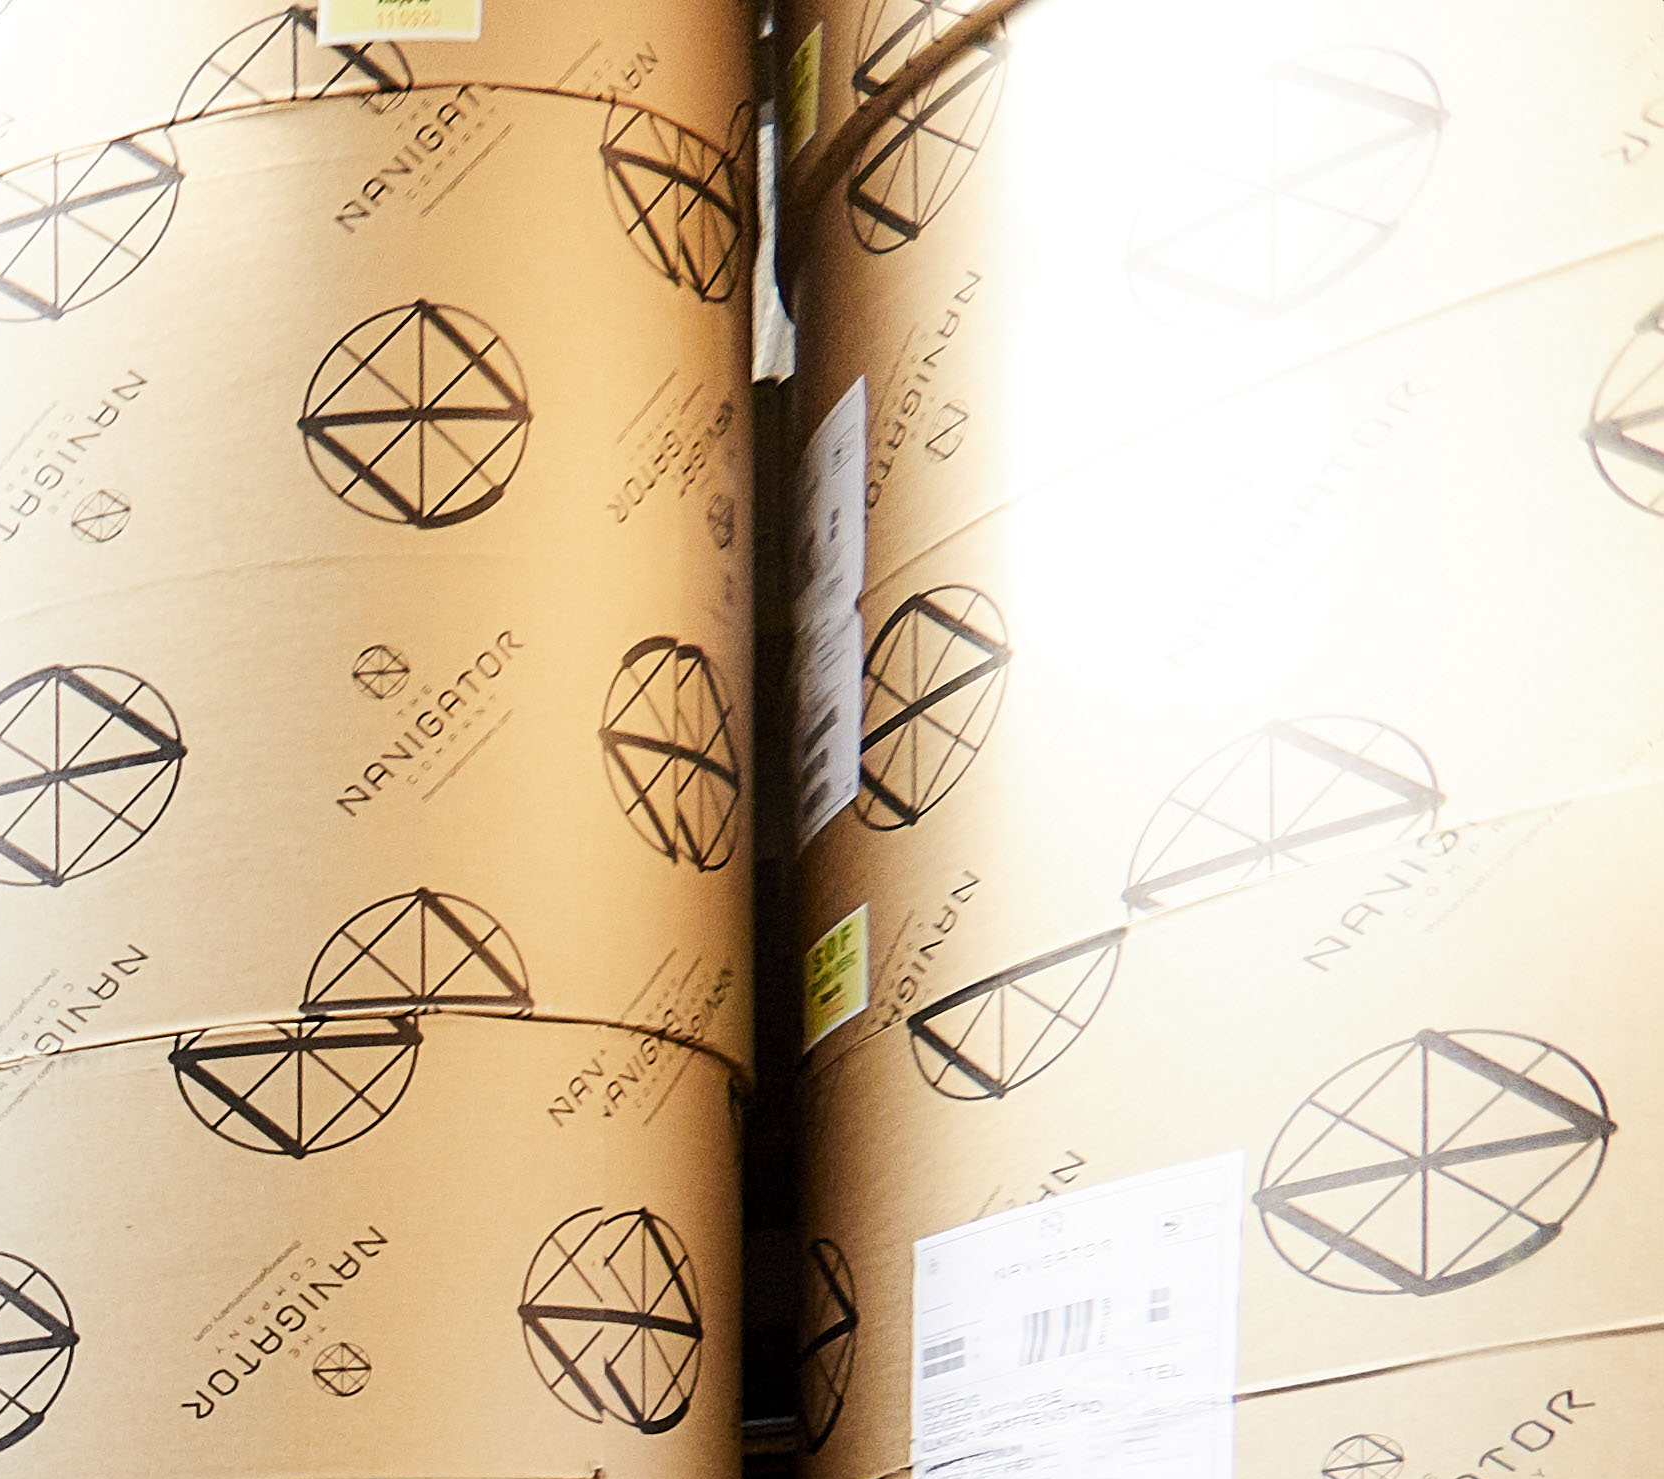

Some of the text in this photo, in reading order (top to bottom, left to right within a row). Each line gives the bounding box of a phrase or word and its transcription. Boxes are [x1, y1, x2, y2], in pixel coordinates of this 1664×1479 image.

[336, 631, 524, 816] NAVIGATOR
[182, 1225, 389, 1420] NAVIGATOR
[216, 1257, 319, 1355] COMPANY
